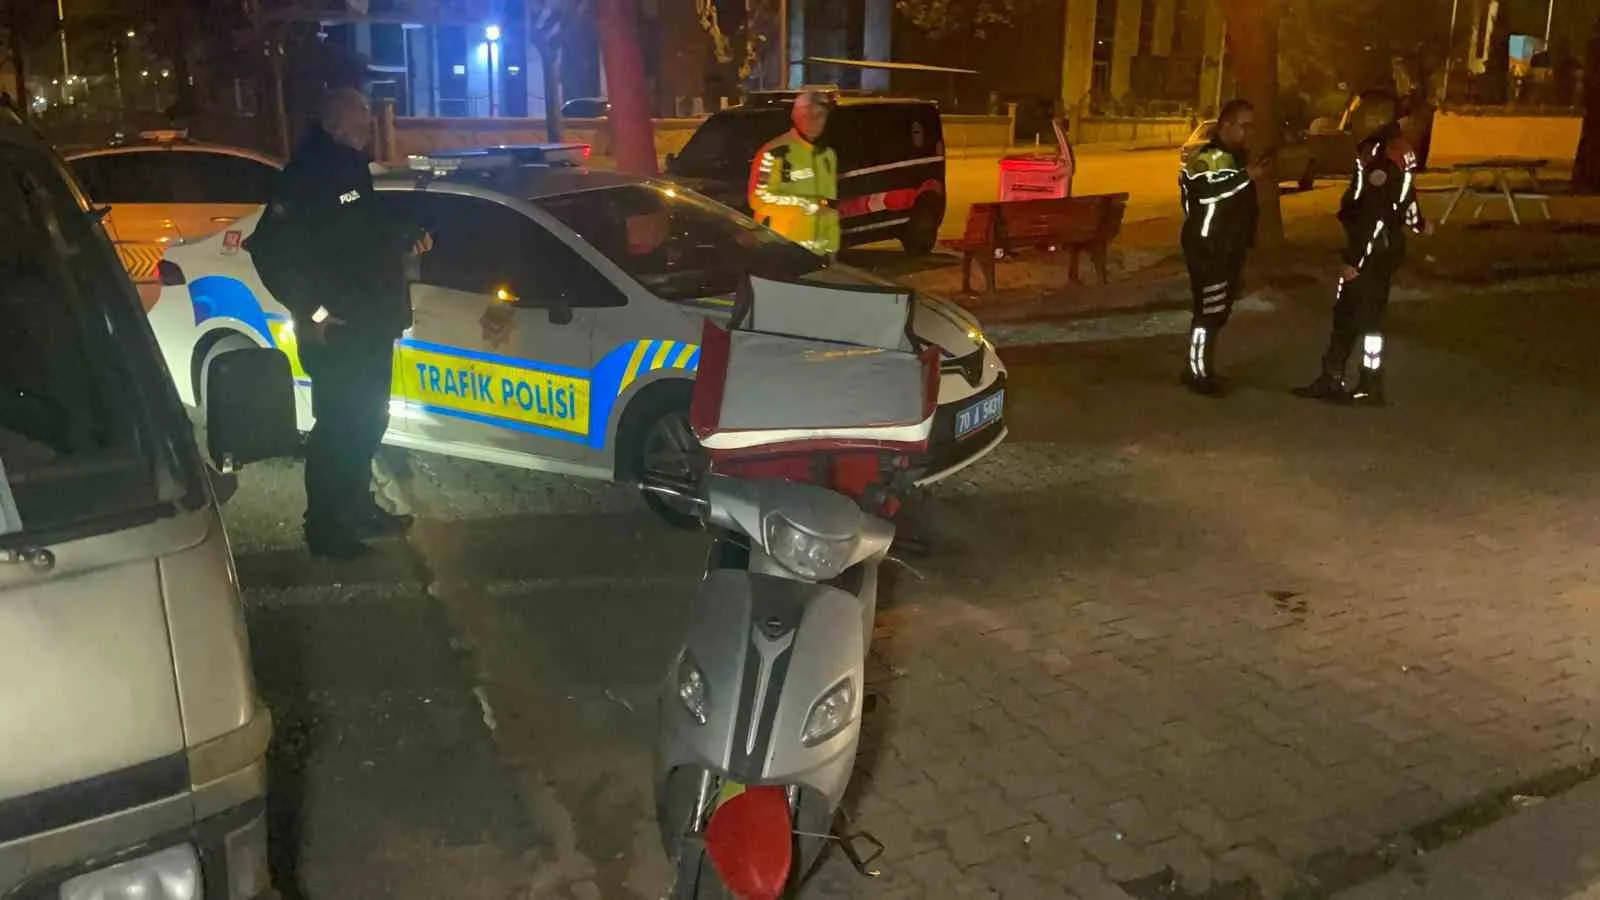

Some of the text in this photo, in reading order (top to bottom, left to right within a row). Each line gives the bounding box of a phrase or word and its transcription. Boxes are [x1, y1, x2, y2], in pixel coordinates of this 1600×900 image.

[416, 363, 576, 421] TRAFİK POLİSİ
[959, 411, 970, 433] 70
